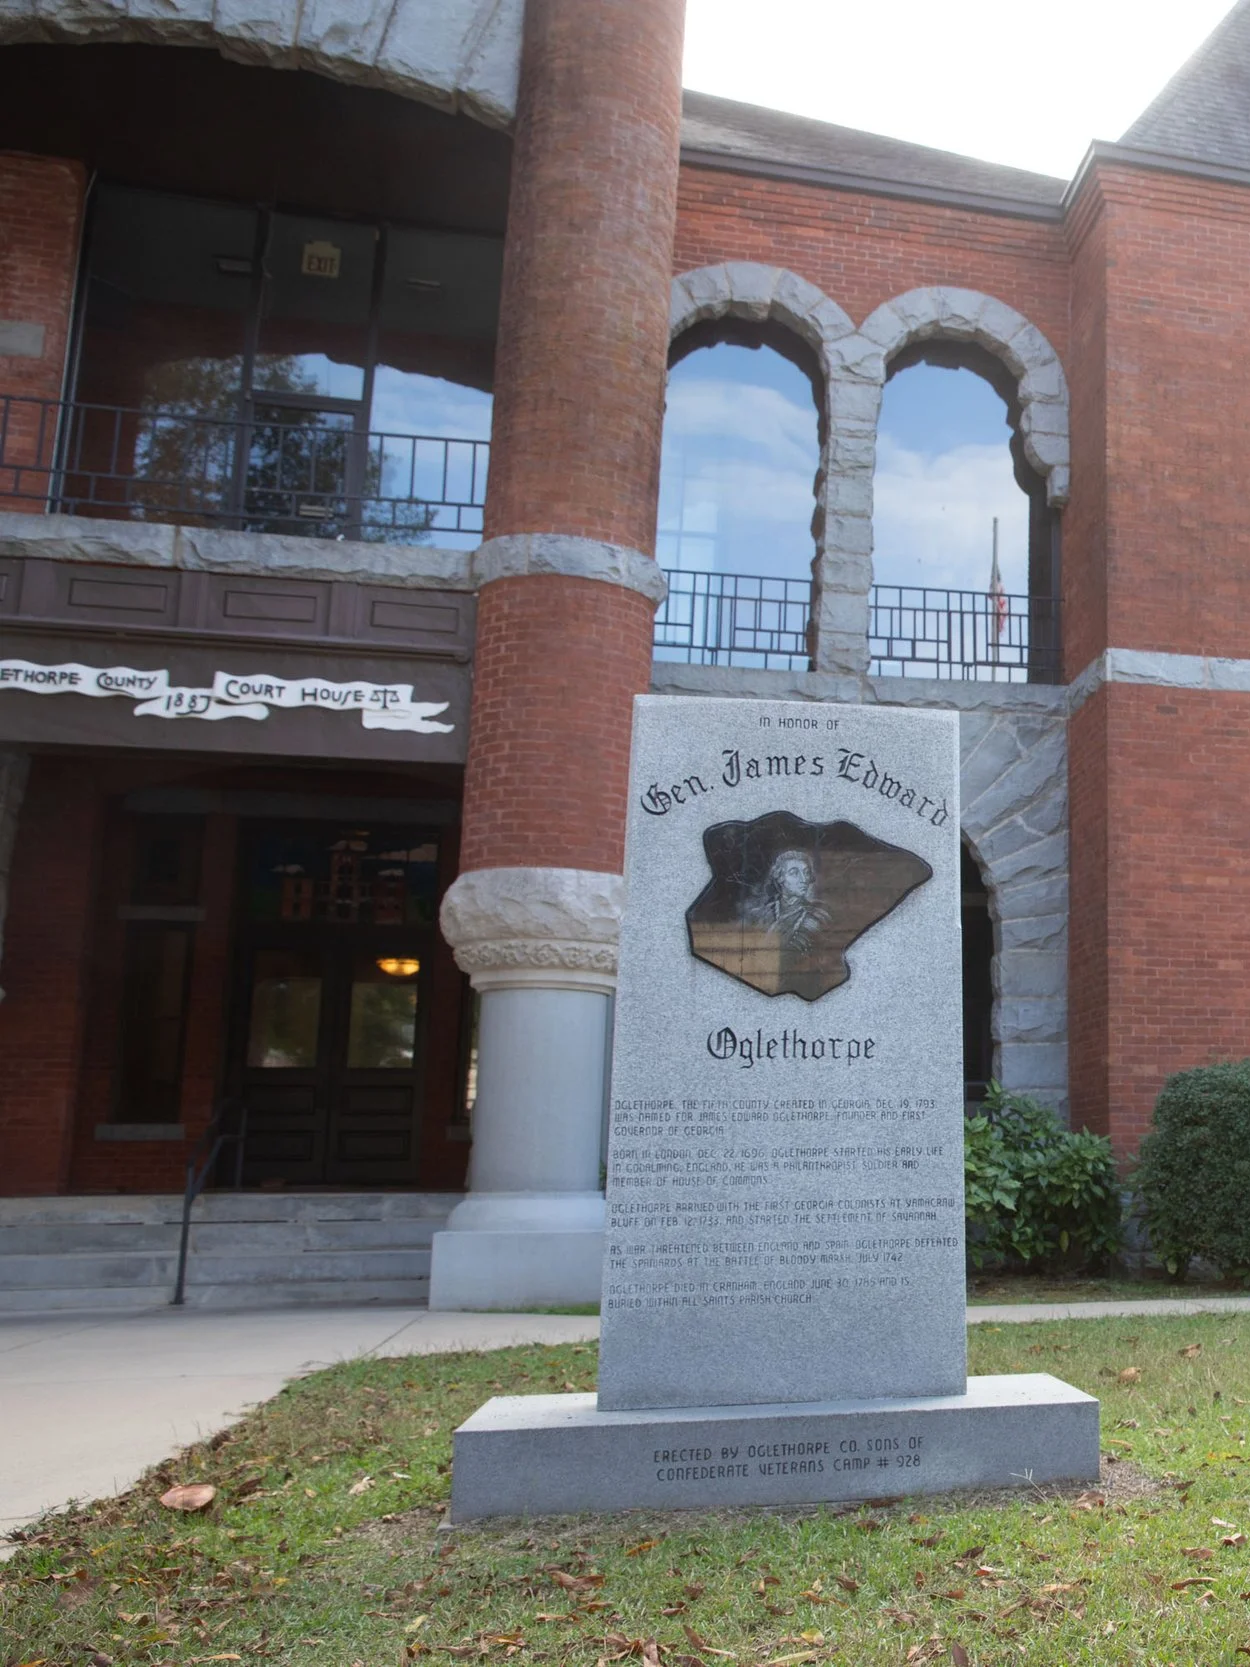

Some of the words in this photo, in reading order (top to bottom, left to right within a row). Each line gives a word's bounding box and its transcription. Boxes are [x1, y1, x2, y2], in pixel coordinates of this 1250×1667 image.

[307, 254, 336, 275] EXIT
[96, 672, 158, 696] COUNTY
[224, 679, 287, 699] COURT
[301, 687, 366, 705] HOUSE
[166, 692, 214, 716] 1887
[759, 716, 771, 728] IN
[779, 717, 819, 730] HONOR
[826, 719, 840, 731] OF
[640, 774, 714, 816] Gen.
[722, 749, 825, 788] James
[836, 748, 951, 828] Edward
[706, 1026, 876, 1069] Oglethorpe
[682, 1099, 698, 1110] THE
[702, 1099, 728, 1109] FIFTH
[732, 1099, 769, 1109] COUNTY
[774, 1099, 815, 1109] CREATED
[818, 1099, 827, 1109] IN
[614, 1113, 634, 1122] WAS
[638, 1112, 671, 1122] NAMED
[676, 1112, 693, 1121] FOR
[699, 1112, 727, 1122] JAMES
[731, 1112, 769, 1122] EDWARD
[837, 1111, 876, 1121] FOUNDER
[881, 1111, 898, 1121] AND
[902, 1111, 926, 1120] FIRST
[614, 1126, 664, 1136] GOVERNOR
[668, 1126, 679, 1136] OF
[613, 1149, 638, 1159] BORN
[642, 1150, 651, 1159] IN
[771, 1148, 828, 1158] OGLETHORPE
[833, 1147, 873, 1157] STARTED
[877, 1147, 891, 1156] HIS
[895, 1147, 922, 1157] EARLY
[926, 1146, 943, 1156] LIFE
[612, 1163, 621, 1173] IN
[735, 1162, 746, 1172] HE
[750, 1161, 769, 1171] WAS
[773, 1162, 779, 1171] A
[902, 1160, 920, 1169] AND
[612, 1177, 651, 1187] MEMBER
[656, 1176, 668, 1187] OF
[672, 1176, 701, 1187] HOUSE
[706, 1176, 717, 1186] OF
[611, 1203, 670, 1214] OGLETHORPE
[675, 1202, 714, 1212] ARRIVED
[716, 1202, 739, 1212] WITH
[744, 1201, 760, 1211] THE
[765, 1200, 789, 1210] FIRST
[794, 1200, 833, 1210] GEORGIA
[838, 1199, 886, 1209] COLONISTS
[890, 1199, 900, 1209] AT
[905, 1198, 955, 1208] YAMACRAW
[611, 1217, 639, 1228] BLUFF
[644, 1217, 656, 1227] ON
[726, 1215, 744, 1225] AND
[749, 1214, 789, 1225] STARTED
[794, 1214, 810, 1223] THE
[815, 1213, 871, 1223] SETTLEMENT
[876, 1212, 887, 1222] OF
[610, 1245, 622, 1255] AS
[626, 1244, 645, 1255] WAR
[651, 1243, 709, 1254] THREATENED
[713, 1242, 754, 1253] BETWEEN
[758, 1241, 799, 1252] ENGLAND
[803, 1240, 821, 1251] AND
[856, 1239, 911, 1249] OGLETHORPE
[914, 1238, 959, 1248] DEFEATED
[610, 1259, 626, 1269] THE
[632, 1258, 683, 1268] SPANIARDS
[687, 1257, 698, 1267] AT
[704, 1256, 721, 1267] THE
[725, 1255, 759, 1266] BATTLE
[764, 1255, 775, 1265] OF
[779, 1254, 816, 1265] BLOODY
[858, 1252, 879, 1263] JULY
[609, 1283, 669, 1295] OGLETHORPE
[674, 1282, 695, 1293] DIED
[699, 1282, 708, 1292] IN
[811, 1278, 832, 1289] JUNE
[879, 1277, 897, 1287] AND
[901, 1276, 910, 1286] IS
[608, 1299, 642, 1309] BURIED
[647, 1297, 678, 1308] WITHIN
[682, 1297, 698, 1307] ALL
[703, 1295, 735, 1306] SAINTS
[739, 1294, 771, 1305] PARISH
[654, 1448, 712, 1463] ERECTED
[721, 1447, 739, 1461] BY
[748, 1442, 830, 1458] OGLETHORPE
[839, 1440, 860, 1454] CO.
[867, 1438, 900, 1451] SONS
[908, 1436, 925, 1450] OF
[656, 1463, 749, 1481] CONFEDERATE
[759, 1459, 824, 1476] VETERANS
[833, 1456, 870, 1471] CAMP
[877, 1456, 889, 1470] #
[897, 1454, 921, 1469] 928
